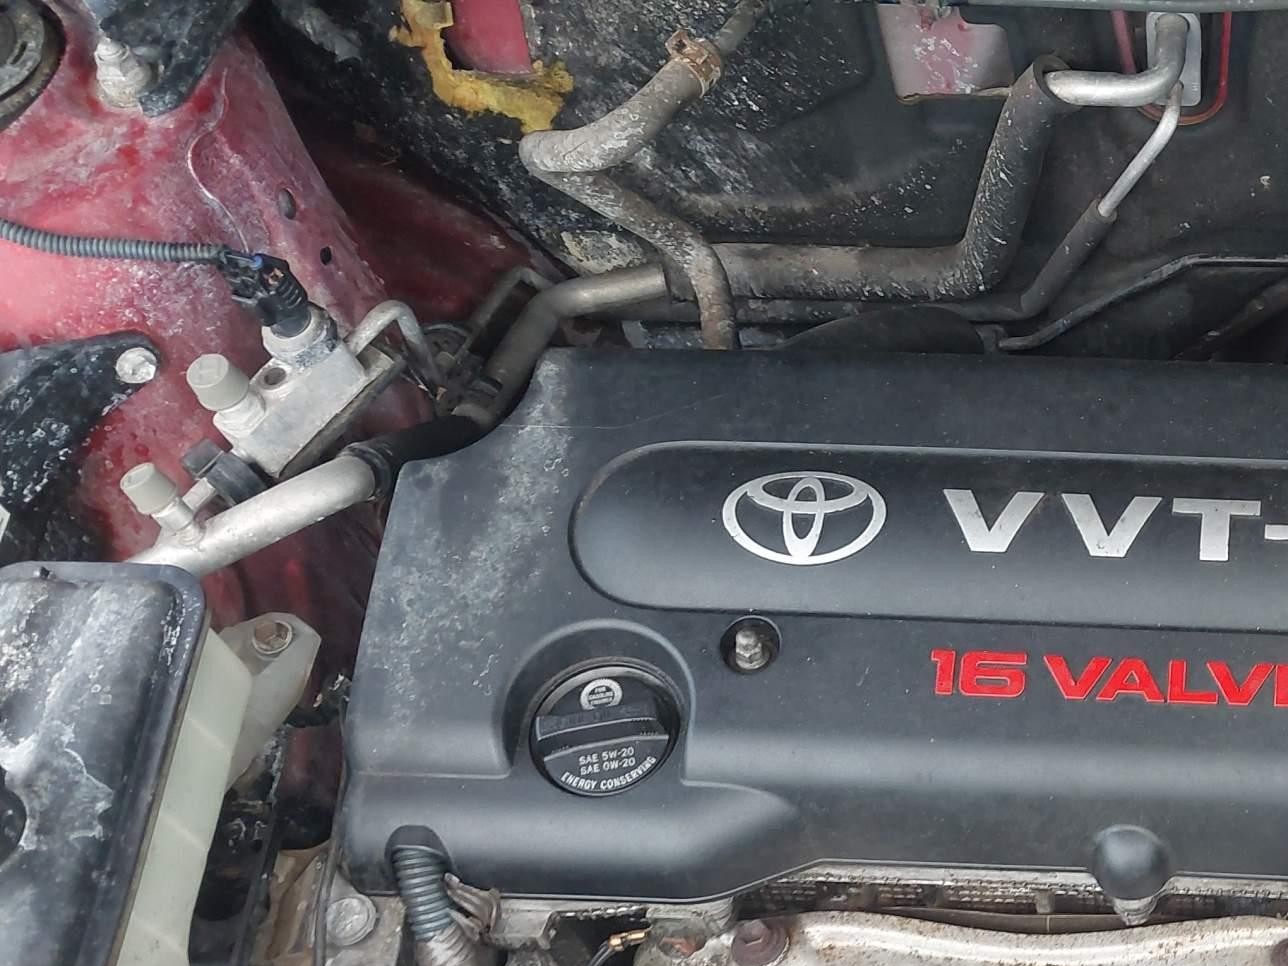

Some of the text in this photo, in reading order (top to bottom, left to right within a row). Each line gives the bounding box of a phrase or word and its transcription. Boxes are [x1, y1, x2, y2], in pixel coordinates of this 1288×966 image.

[930, 648, 1027, 697] 16
[579, 746, 635, 766] SAE 5W-20
[580, 756, 636, 776] SAE 0W-20
[560, 755, 657, 791] ENERGY CONSERVING
